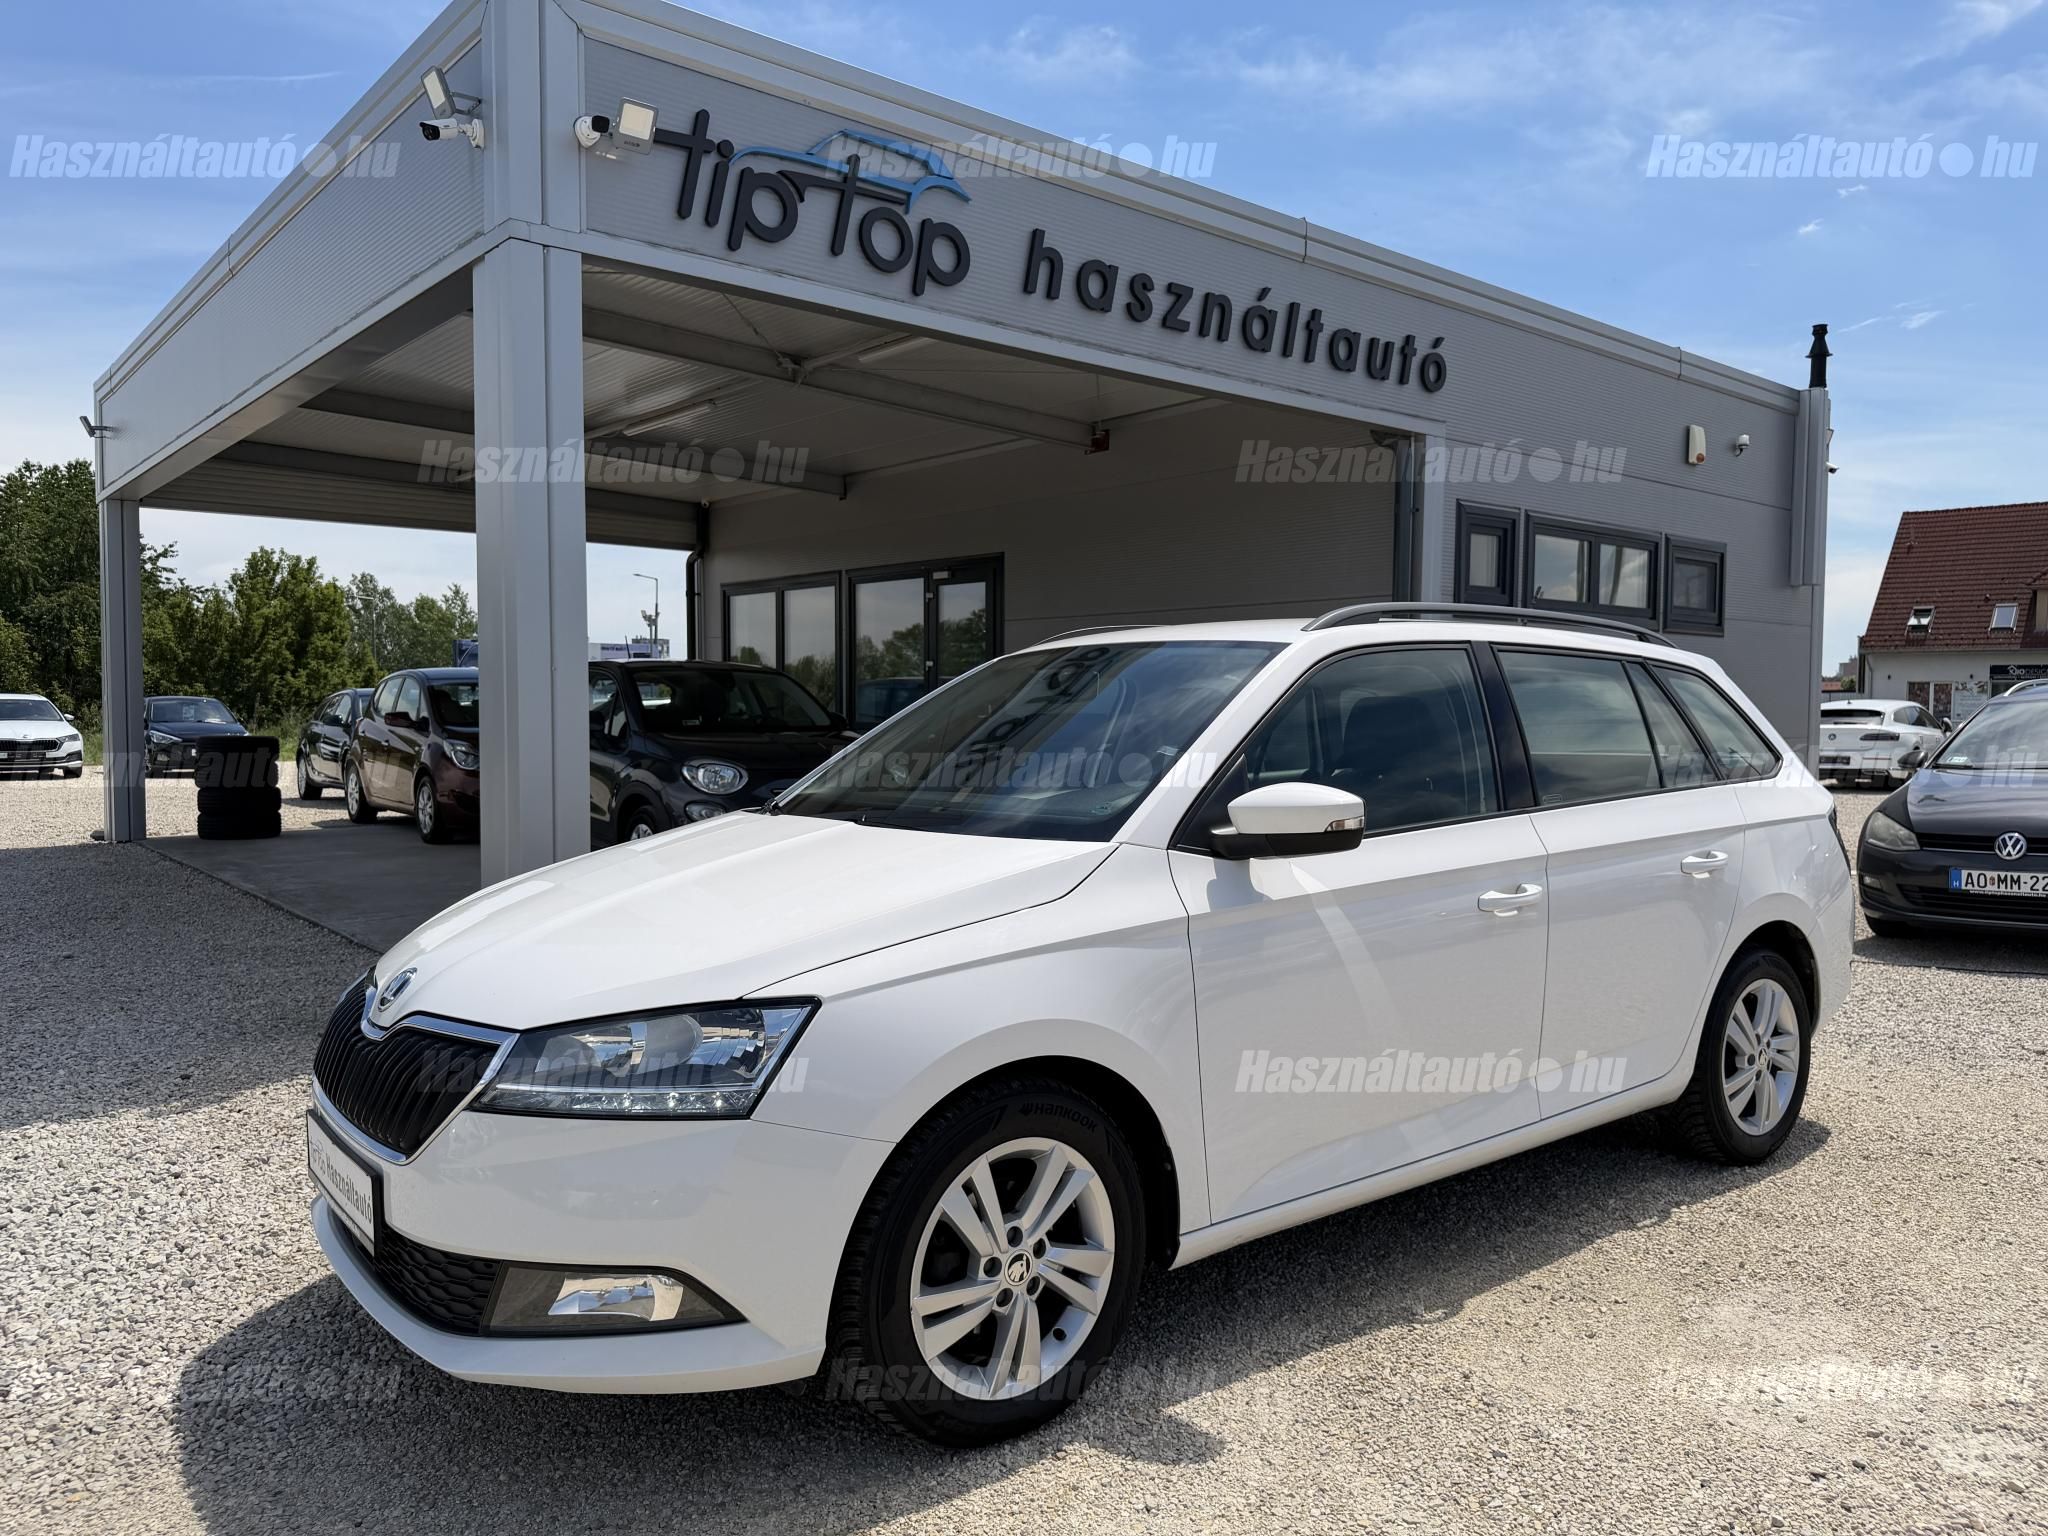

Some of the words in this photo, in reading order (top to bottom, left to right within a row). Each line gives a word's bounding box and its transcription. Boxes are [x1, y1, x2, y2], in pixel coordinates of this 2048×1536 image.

[1023, 228, 1447, 393] használtautó
[1965, 872, 1988, 889] AO
[326, 1152, 373, 1225] Használtautó
